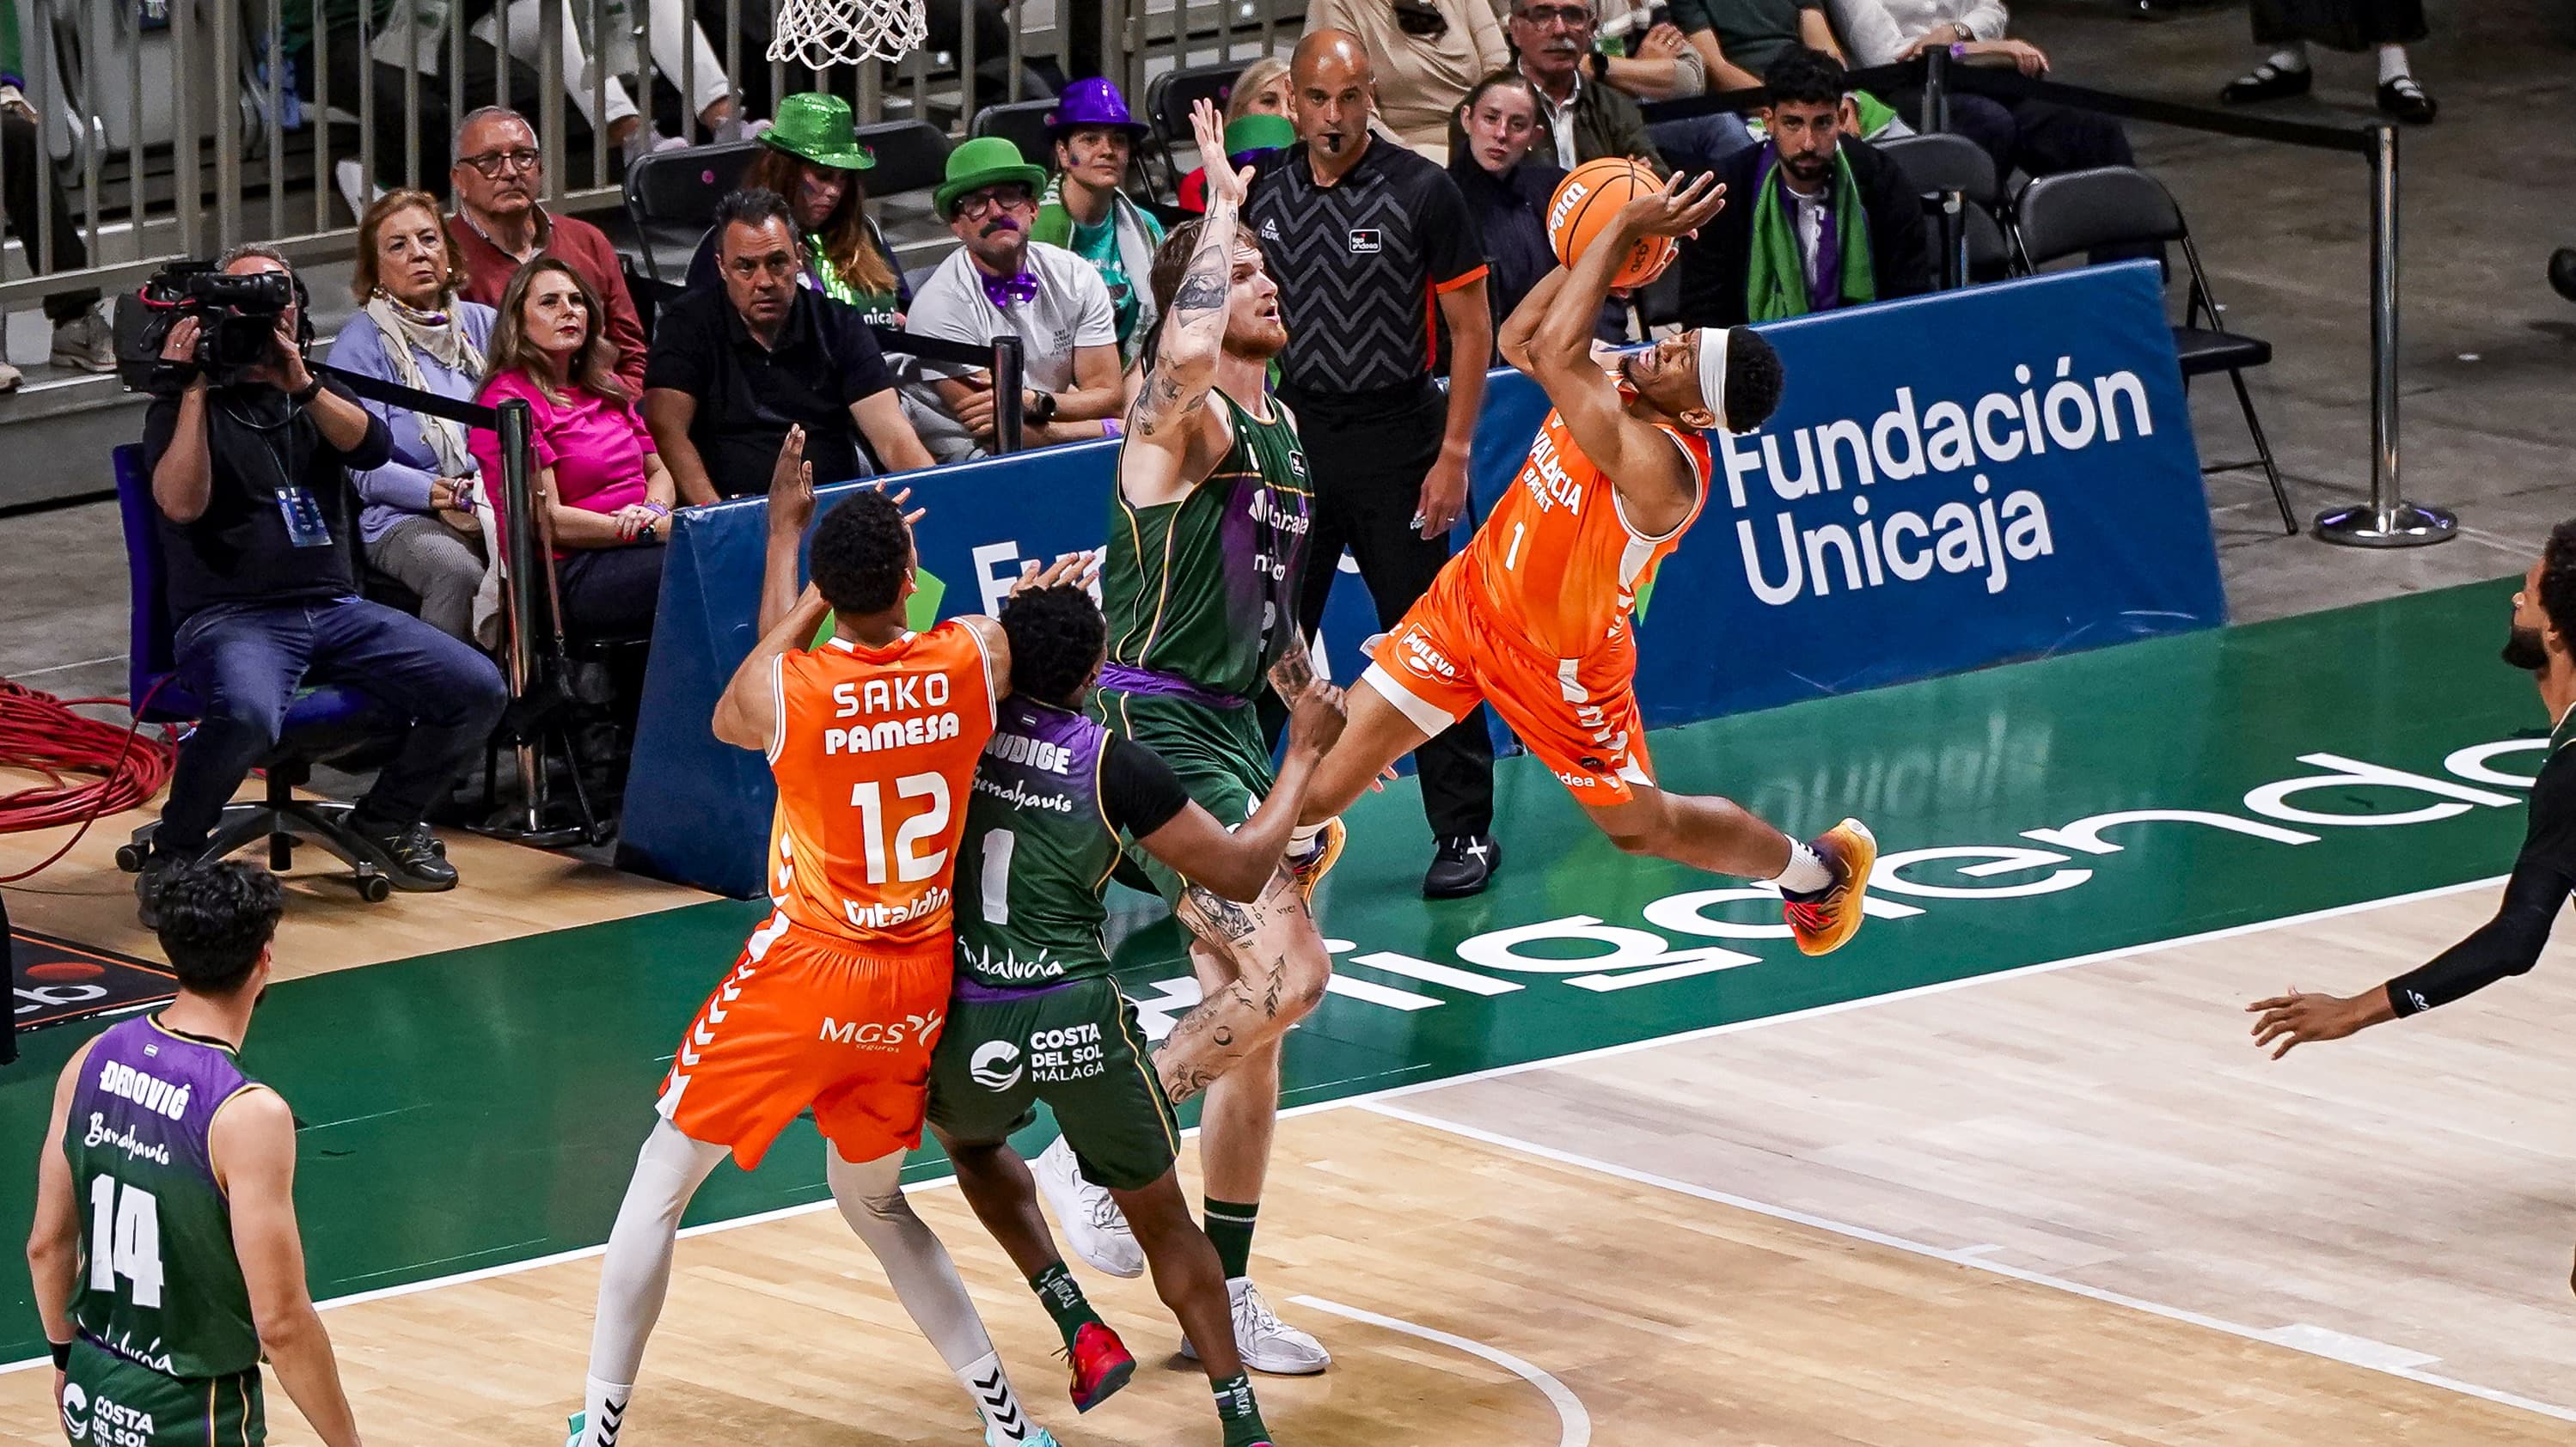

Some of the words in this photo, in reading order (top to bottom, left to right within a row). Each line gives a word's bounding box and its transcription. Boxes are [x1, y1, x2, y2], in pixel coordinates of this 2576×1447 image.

[1717, 356, 2153, 508] Fundación
[1505, 521, 1526, 571] 1
[1736, 473, 2054, 606] Unicaja
[1402, 632, 1455, 677] PULEVA
[832, 672, 950, 718] SAKO
[824, 712, 960, 755] PAMESA
[850, 771, 951, 884] 12
[981, 827, 1014, 925] 1
[819, 1017, 906, 1044] MGS
[1031, 1023, 1102, 1051] COSTA
[1031, 1050, 1069, 1069] DEL
[1073, 1044, 1104, 1063] SOL
[1031, 1064, 1105, 1084] MÁLAGA
[90, 1173, 164, 1310] 14
[92, 1415, 113, 1441] DEL
[114, 1427, 147, 1447] SOL
[95, 1395, 155, 1435] COSTA
